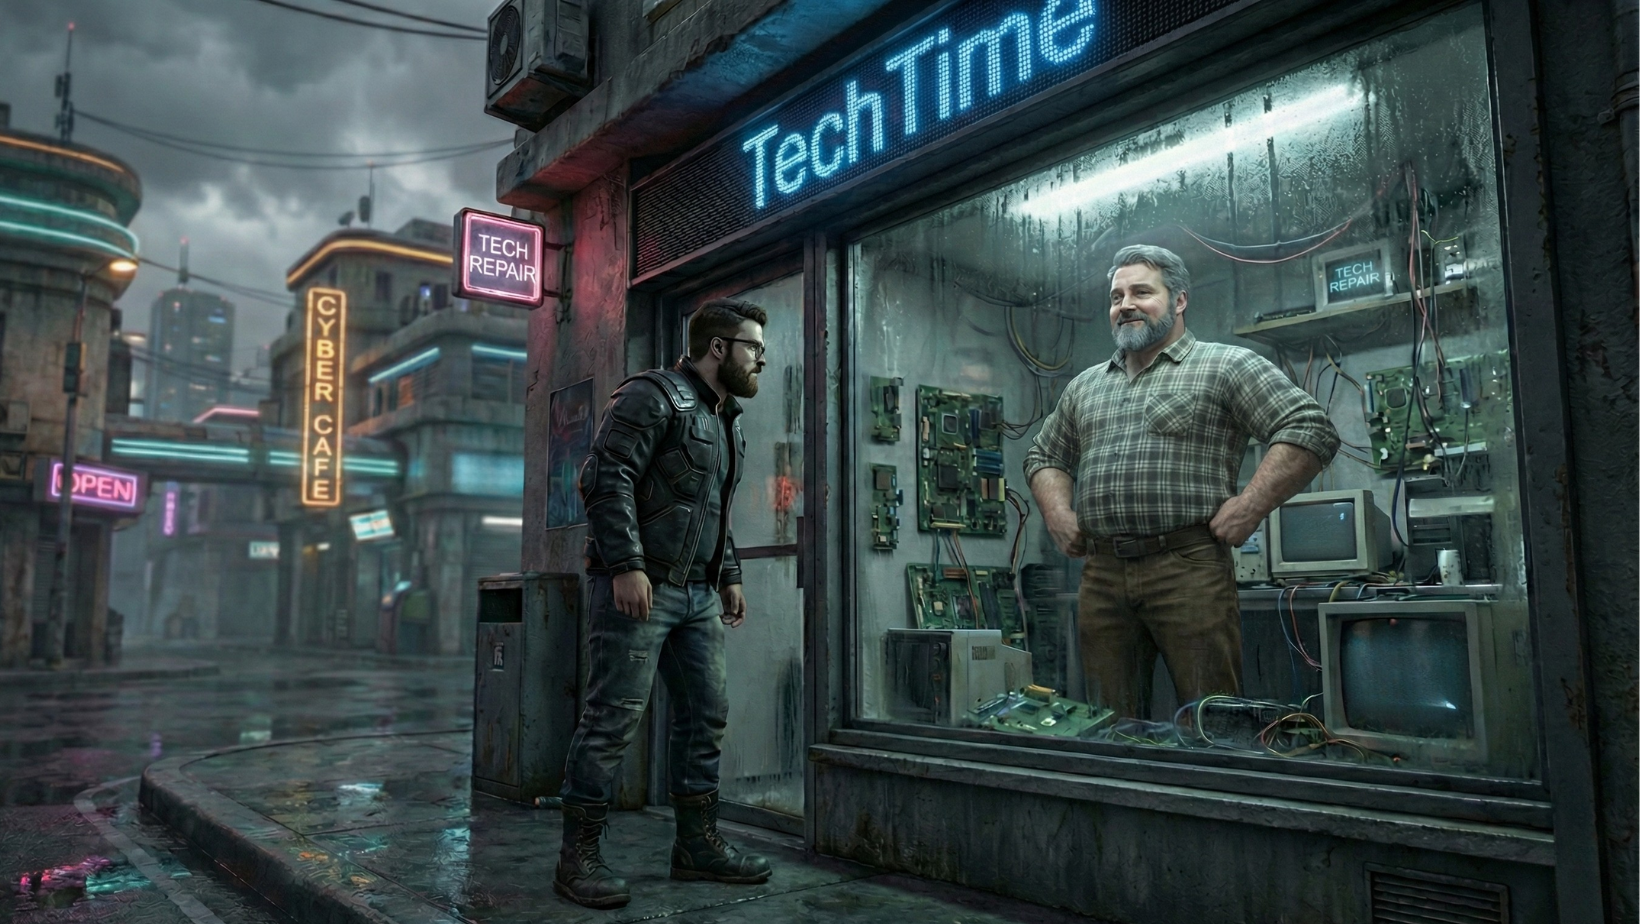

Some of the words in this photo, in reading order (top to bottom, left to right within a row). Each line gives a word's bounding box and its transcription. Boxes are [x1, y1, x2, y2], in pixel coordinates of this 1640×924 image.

[478, 234, 529, 260] TECH
[469, 254, 537, 284] REPAIR
[1329, 272, 1380, 293] REPAIR
[1335, 261, 1373, 279] TECH
[314, 296, 337, 402] CYBER
[312, 414, 333, 500] CAFE
